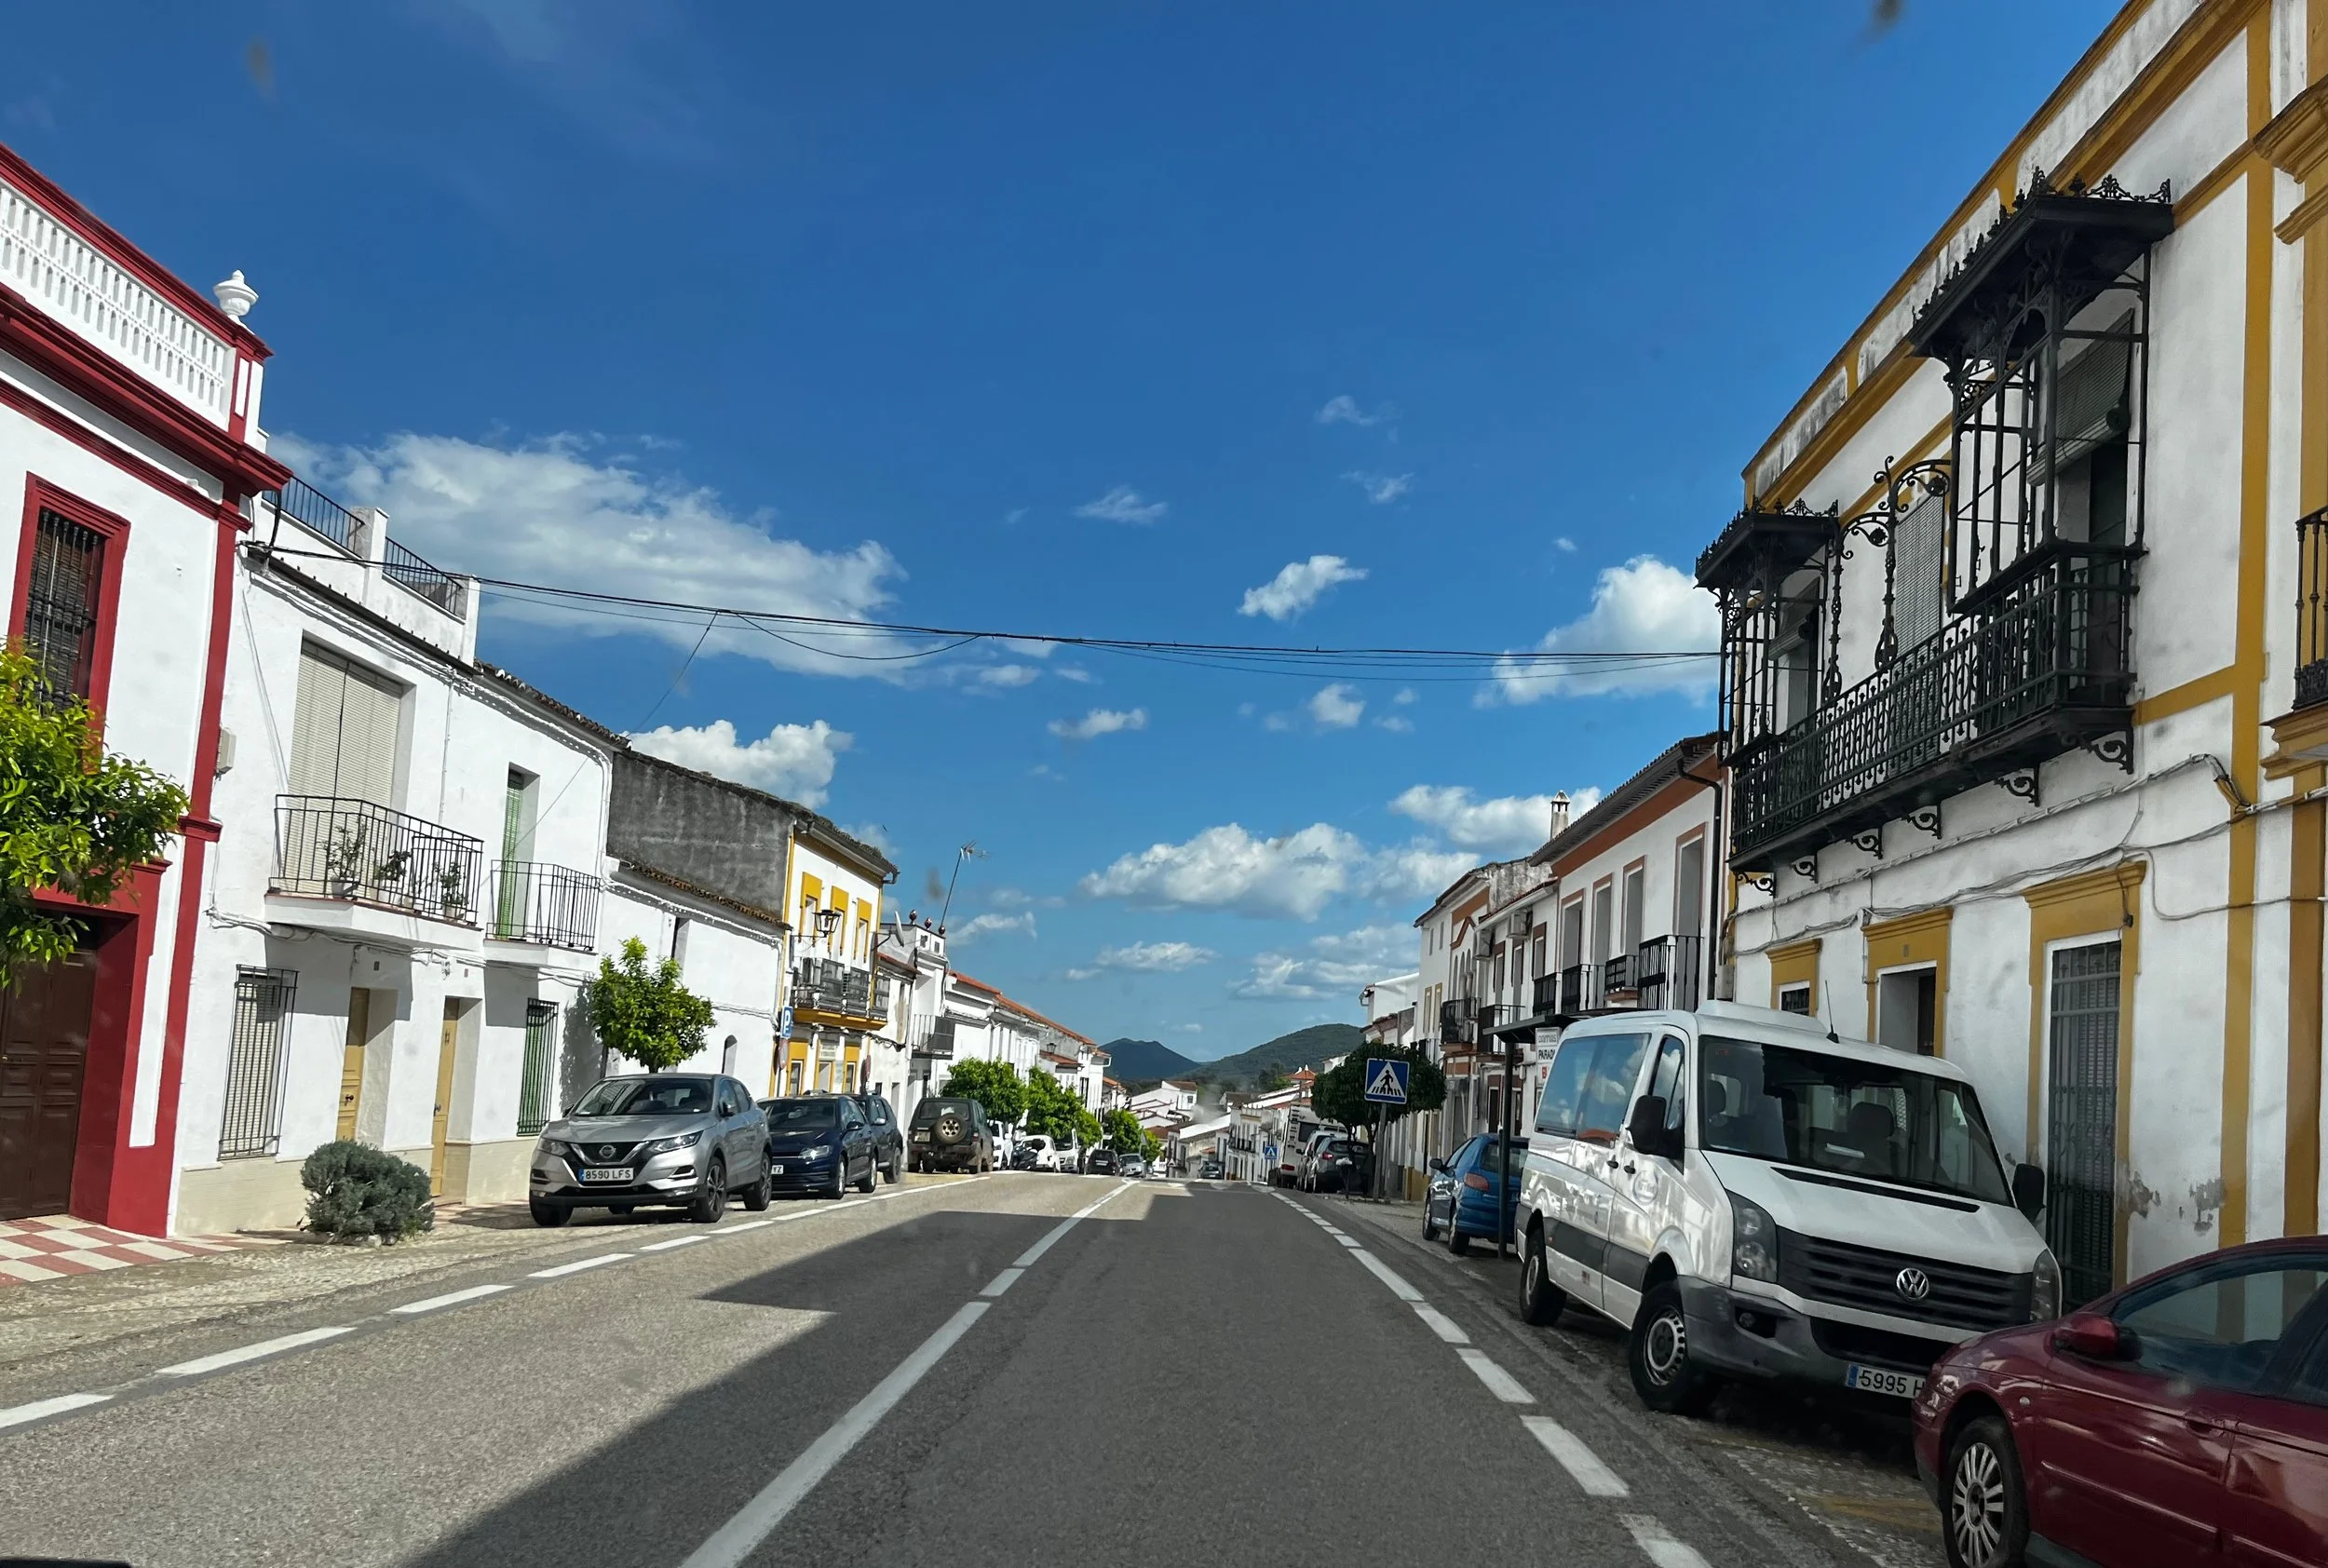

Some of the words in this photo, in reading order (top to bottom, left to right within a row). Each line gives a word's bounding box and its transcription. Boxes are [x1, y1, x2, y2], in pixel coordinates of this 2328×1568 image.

[1538, 1048, 1555, 1061] PARAD
[586, 1170, 610, 1180] 8590
[612, 1169, 631, 1179] LFS
[1859, 1370, 1908, 1394] 5995
[1913, 1379, 1927, 1397] H
